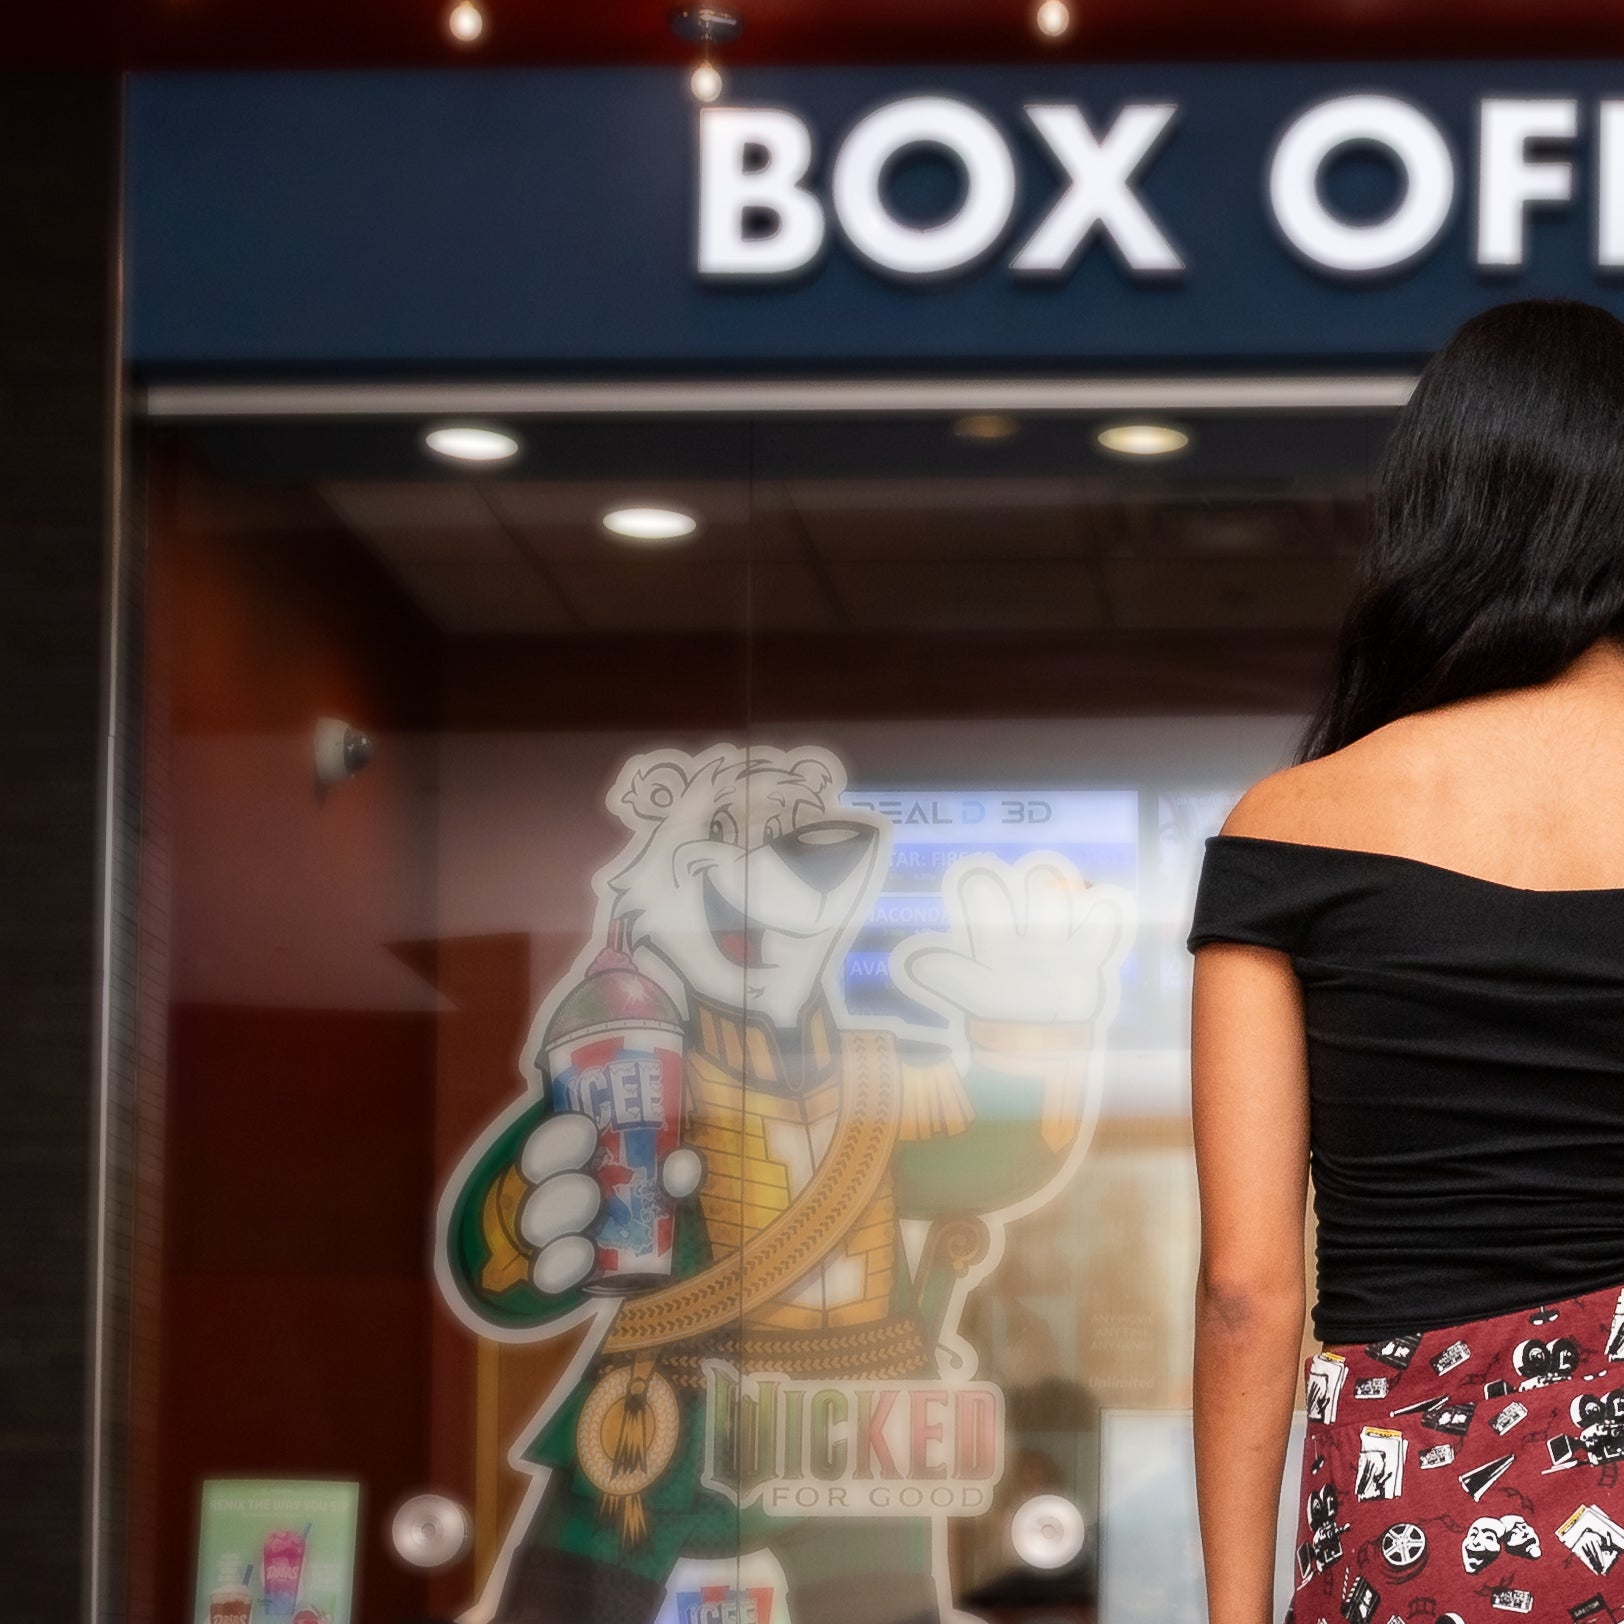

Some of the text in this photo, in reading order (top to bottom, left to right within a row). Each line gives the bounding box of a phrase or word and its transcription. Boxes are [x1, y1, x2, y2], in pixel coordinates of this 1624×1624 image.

[697, 97, 1186, 273] BOX
[1001, 801, 1052, 824] 3D
[710, 1367, 997, 1498] WICKED
[772, 1487, 983, 1507] FOR GOOD
